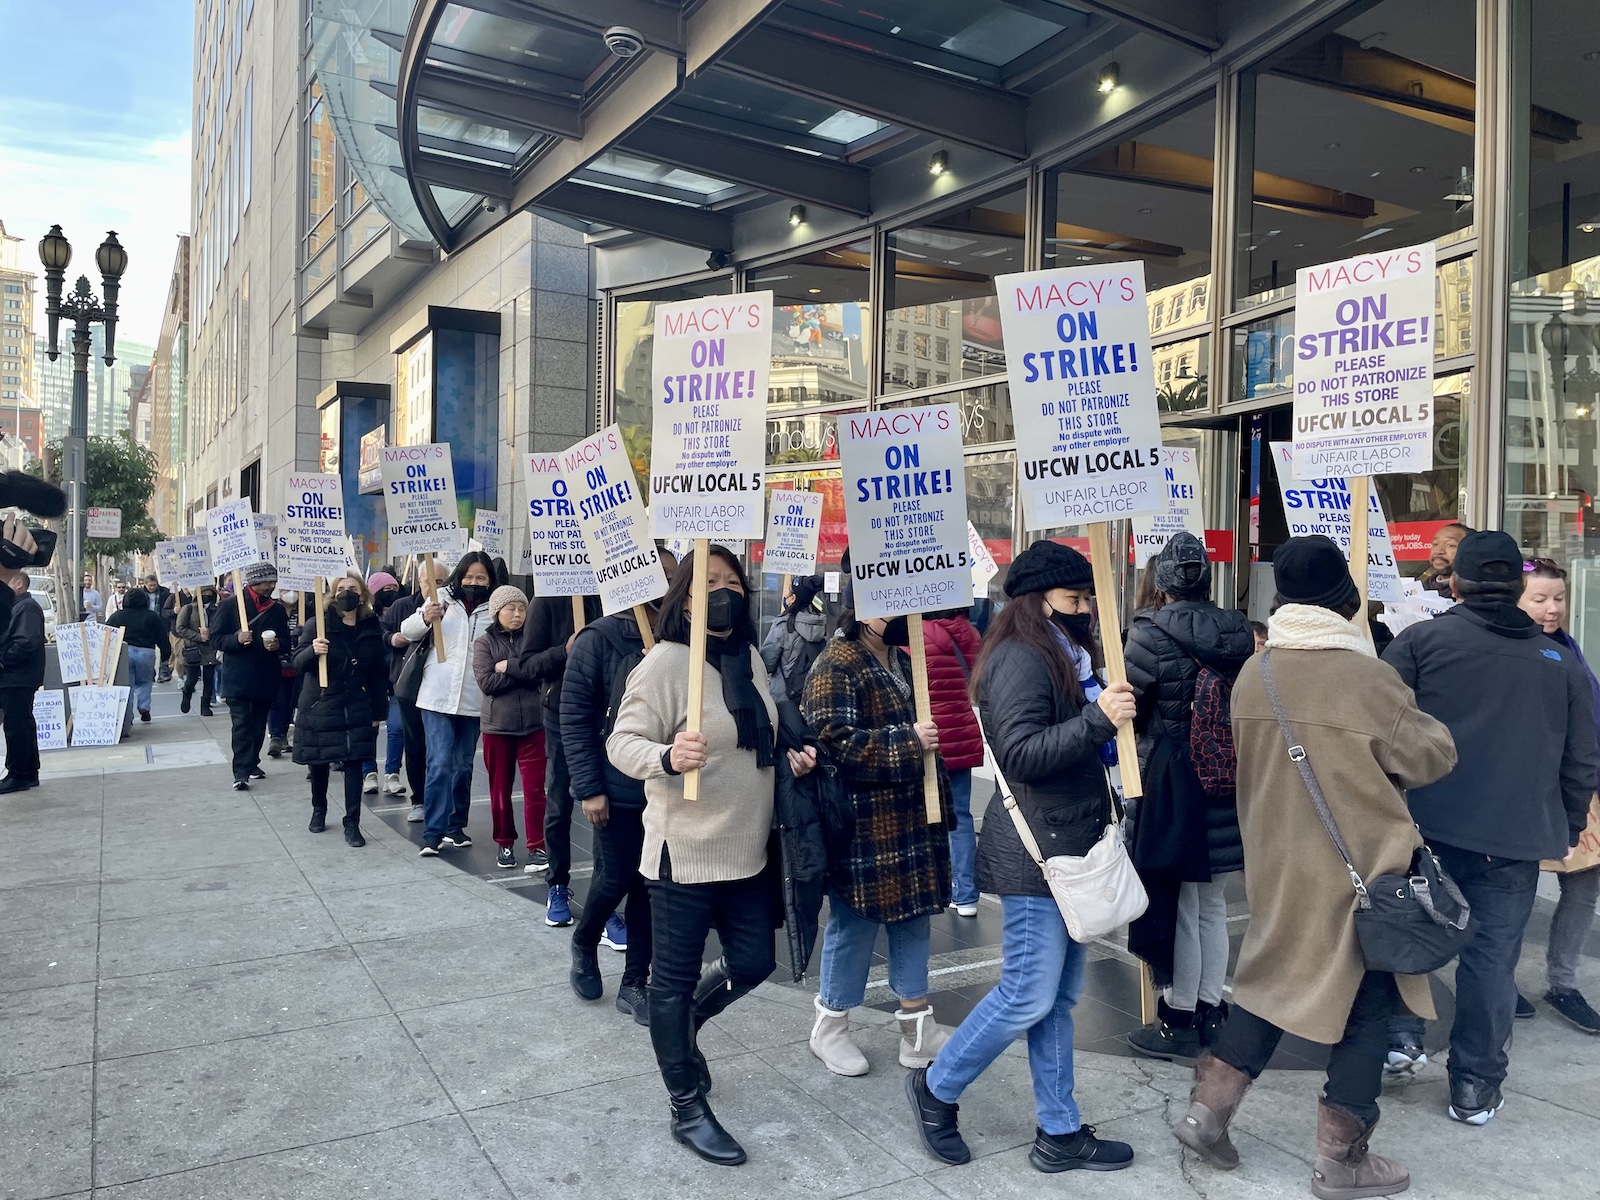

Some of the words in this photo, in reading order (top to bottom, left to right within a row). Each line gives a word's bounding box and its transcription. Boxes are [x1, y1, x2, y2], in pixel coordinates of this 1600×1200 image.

[1309, 252, 1421, 292] MACY'S
[1016, 277, 1134, 311] MACY'S
[1336, 294, 1386, 326] ON
[665, 304, 760, 336] MACY'S
[1057, 311, 1098, 343] ON
[1298, 316, 1429, 360] STRIKE!
[691, 339, 724, 368] ON
[1023, 343, 1138, 382] STRIKE!
[1335, 355, 1385, 373] PLEASE
[663, 370, 755, 404] STRIKE!
[1068, 380, 1102, 396] PLEASE
[1298, 381, 1316, 394] DO
[1321, 376, 1347, 391] NOT
[1352, 366, 1426, 387] PATRONIZE
[1042, 402, 1054, 416] DO
[1059, 400, 1077, 414] NOT
[1082, 393, 1130, 411] PATRONIZE
[1321, 393, 1349, 407] THIS
[1355, 387, 1398, 403] STORE
[694, 404, 719, 418] PLEASE
[1298, 412, 1347, 433] UFCW
[1352, 405, 1412, 427] LOCAL
[1418, 404, 1428, 420] 5
[673, 423, 682, 435] DO
[685, 422, 698, 434] NOT
[702, 419, 742, 433] PATRONIZE
[851, 410, 949, 439] MACY'S
[1058, 416, 1082, 431] THIS
[1088, 412, 1119, 428] STORE
[1059, 433, 1070, 441] No
[1072, 429, 1102, 440] dispute
[1104, 426, 1121, 435] with
[1306, 440, 1332, 448] DISPUTE
[1390, 432, 1426, 441] EMPLOYER
[684, 438, 700, 449] THIS
[704, 436, 729, 448] STORE
[1069, 441, 1091, 449] other
[1093, 436, 1130, 448] employer
[385, 447, 442, 462] MACY'S
[565, 433, 617, 473] MACY'S
[691, 451, 714, 461] dispute
[885, 444, 919, 470] ON
[1311, 451, 1357, 464] UNFAIR
[1362, 447, 1410, 460] LABOR
[406, 464, 426, 478] ON
[1025, 456, 1079, 480] UFCW
[1085, 449, 1144, 473] LOCAL
[1150, 448, 1159, 465] 5
[1326, 461, 1392, 476] PRACTICE
[289, 477, 337, 490] MACY'S
[586, 465, 608, 490] ON
[654, 475, 693, 494] UFCW
[698, 473, 747, 492] LOCAL
[752, 473, 760, 491] 5
[857, 469, 952, 502] STRIKE!
[1311, 478, 1347, 490] ON
[391, 478, 446, 495] STRIKE!
[1045, 487, 1096, 504] UNFAIR
[1101, 481, 1147, 498] LABOR
[302, 492, 324, 505] ON
[580, 480, 632, 520] STRIKE!
[776, 493, 818, 504] MACY'S
[893, 500, 921, 513] PLEASE
[88, 509, 98, 517] NO
[209, 501, 246, 520] MACY'S
[287, 505, 342, 519] STRIKE!
[530, 499, 575, 516] STRI
[663, 506, 701, 518] UNFAIR
[705, 505, 744, 517] LABOR
[788, 505, 802, 515] ON
[1064, 498, 1133, 517] PRACTICE
[222, 513, 236, 524] ON
[601, 510, 618, 524] PLEASE
[774, 515, 814, 528] STRIKE!
[872, 518, 881, 529] DO
[885, 516, 900, 527] NOT
[904, 510, 944, 525] PATRONIZE
[1319, 513, 1350, 523] PLEAS
[212, 519, 249, 536] STRIKE!
[391, 525, 417, 535] UFCW
[420, 523, 449, 533] LOCAL
[477, 526, 503, 535] STRIKE!
[675, 520, 729, 532] PRACTICE
[885, 529, 903, 540] THIS
[909, 525, 934, 538] STORE
[1293, 524, 1308, 533] DO
[1311, 525, 1331, 534] NOT
[603, 536, 613, 548] THIS
[616, 530, 630, 543] STORE
[896, 540, 920, 548] dispute
[1136, 534, 1164, 545] UFCW
[179, 550, 207, 559] STRIKE!
[290, 544, 311, 553] UFCW
[314, 546, 337, 555] LOCAL
[967, 527, 994, 573] MACY'S
[534, 554, 565, 565] UFCW
[596, 564, 620, 584] UFCW
[621, 554, 650, 575] LOCAL
[651, 550, 657, 563] 5
[856, 560, 900, 580] UFCW
[905, 553, 954, 574] LOCAL
[959, 552, 966, 566] 5
[1386, 555, 1393, 567] 5
[556, 586, 596, 594] PRACTICE
[608, 584, 631, 599] UNFAIR
[631, 575, 655, 591] LABOR
[871, 586, 912, 601] UNFAIR
[916, 581, 954, 595] LABOR
[618, 588, 650, 606] PRACTICE
[886, 595, 942, 611] PRACTICE
